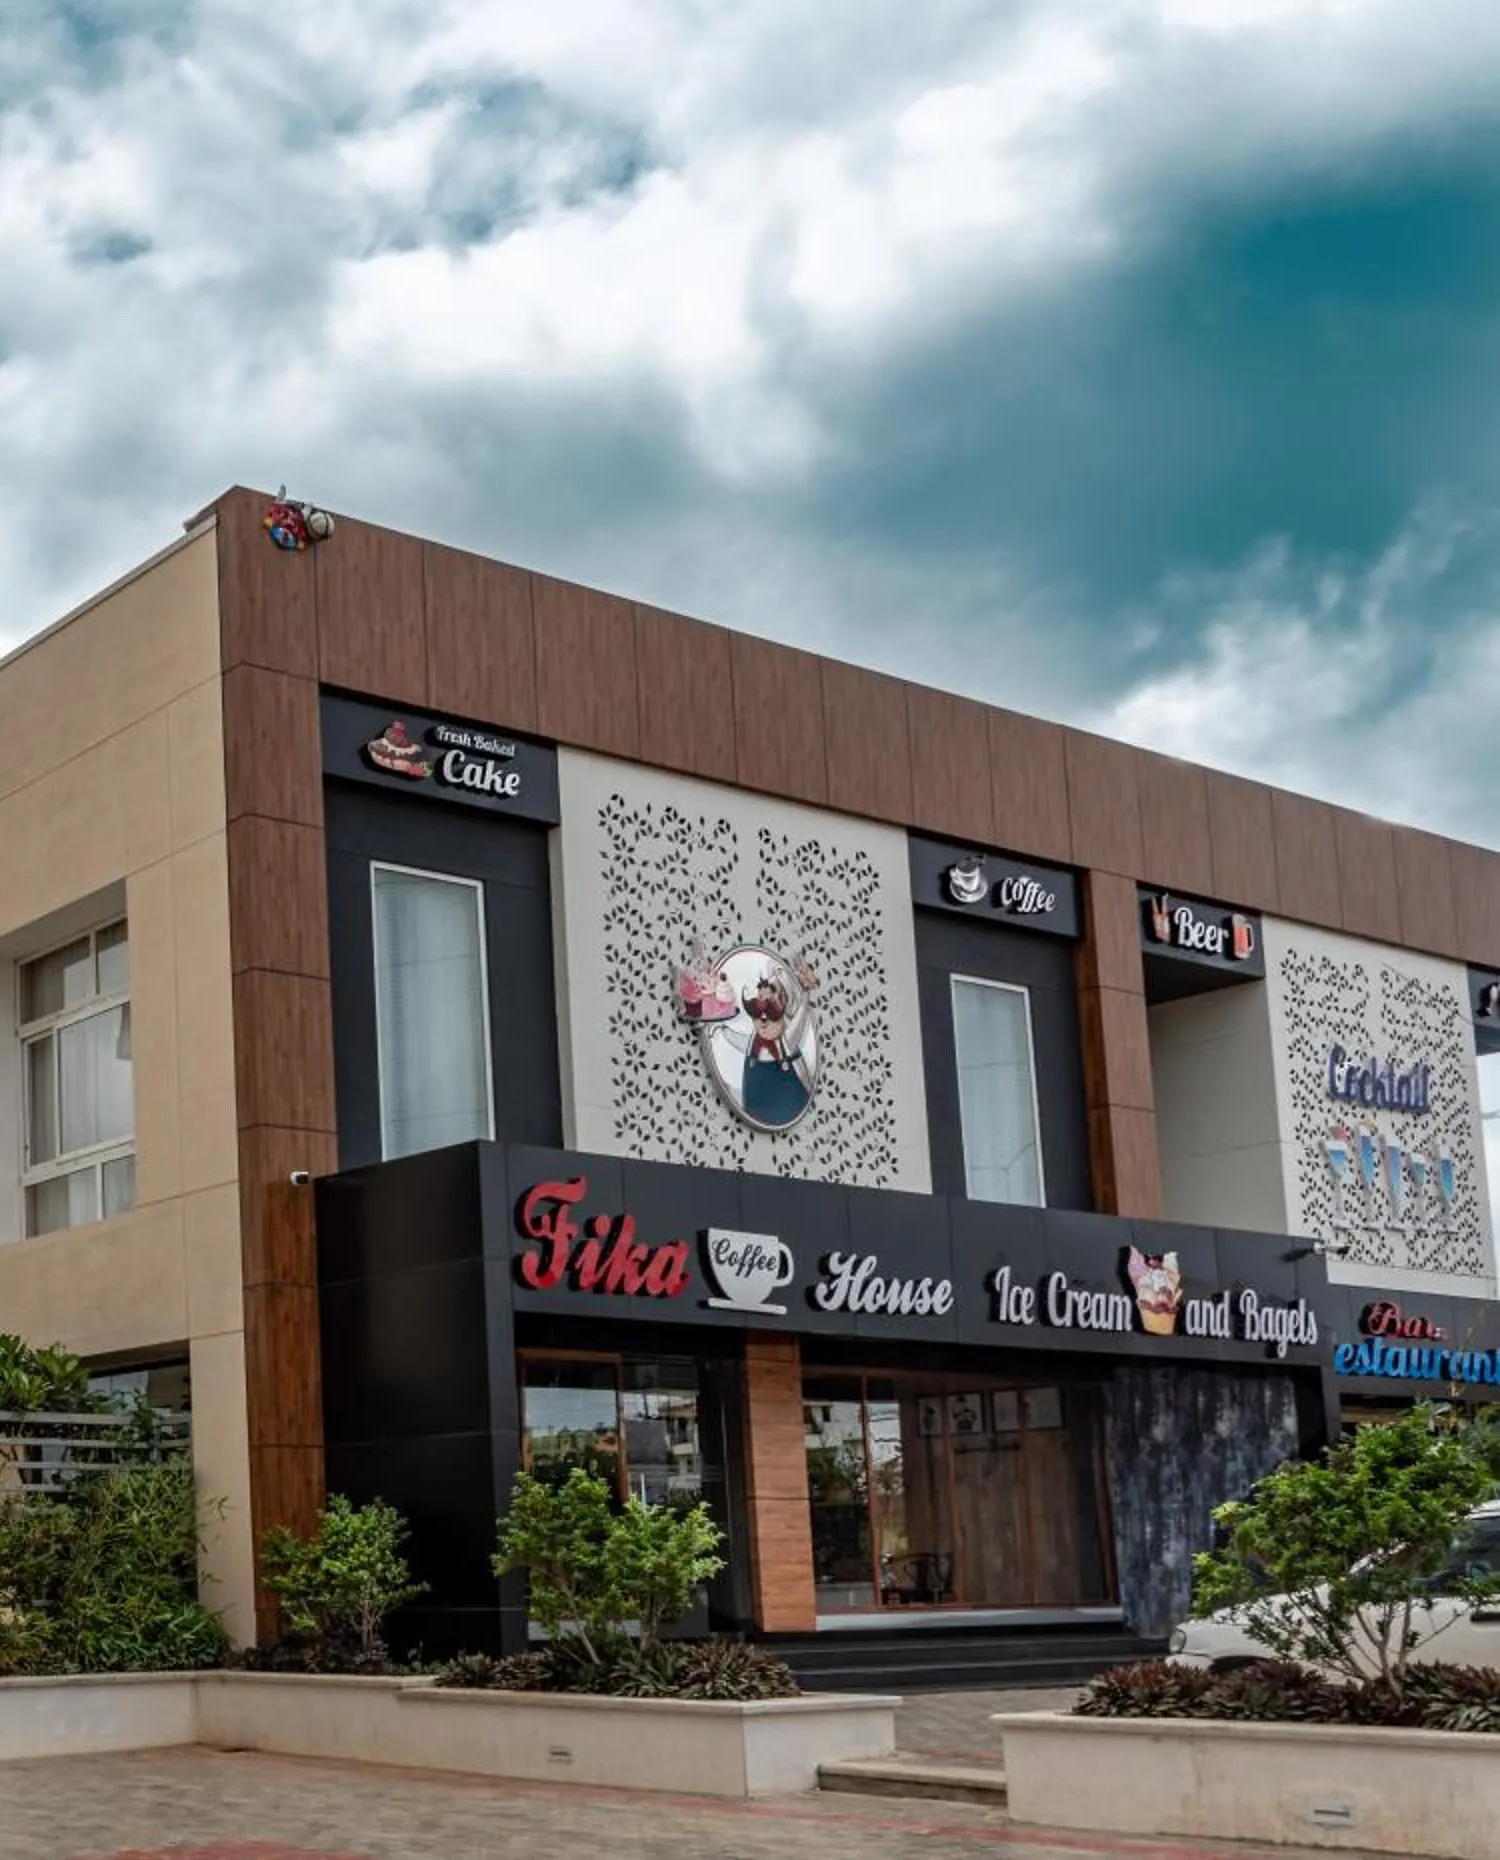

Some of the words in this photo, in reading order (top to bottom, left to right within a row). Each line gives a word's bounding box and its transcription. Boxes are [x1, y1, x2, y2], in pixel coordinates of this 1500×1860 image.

[442, 749, 521, 796] Cake
[1001, 876, 1056, 913] Coffee
[1174, 907, 1229, 953] Beer
[522, 1175, 692, 1296] Fika
[711, 1238, 779, 1279] Coffee
[815, 1251, 954, 1316] House
[995, 1265, 1035, 1326] Ice
[1047, 1271, 1132, 1332] Cream
[1185, 1290, 1231, 1338] and
[1239, 1288, 1318, 1358] Bagels
